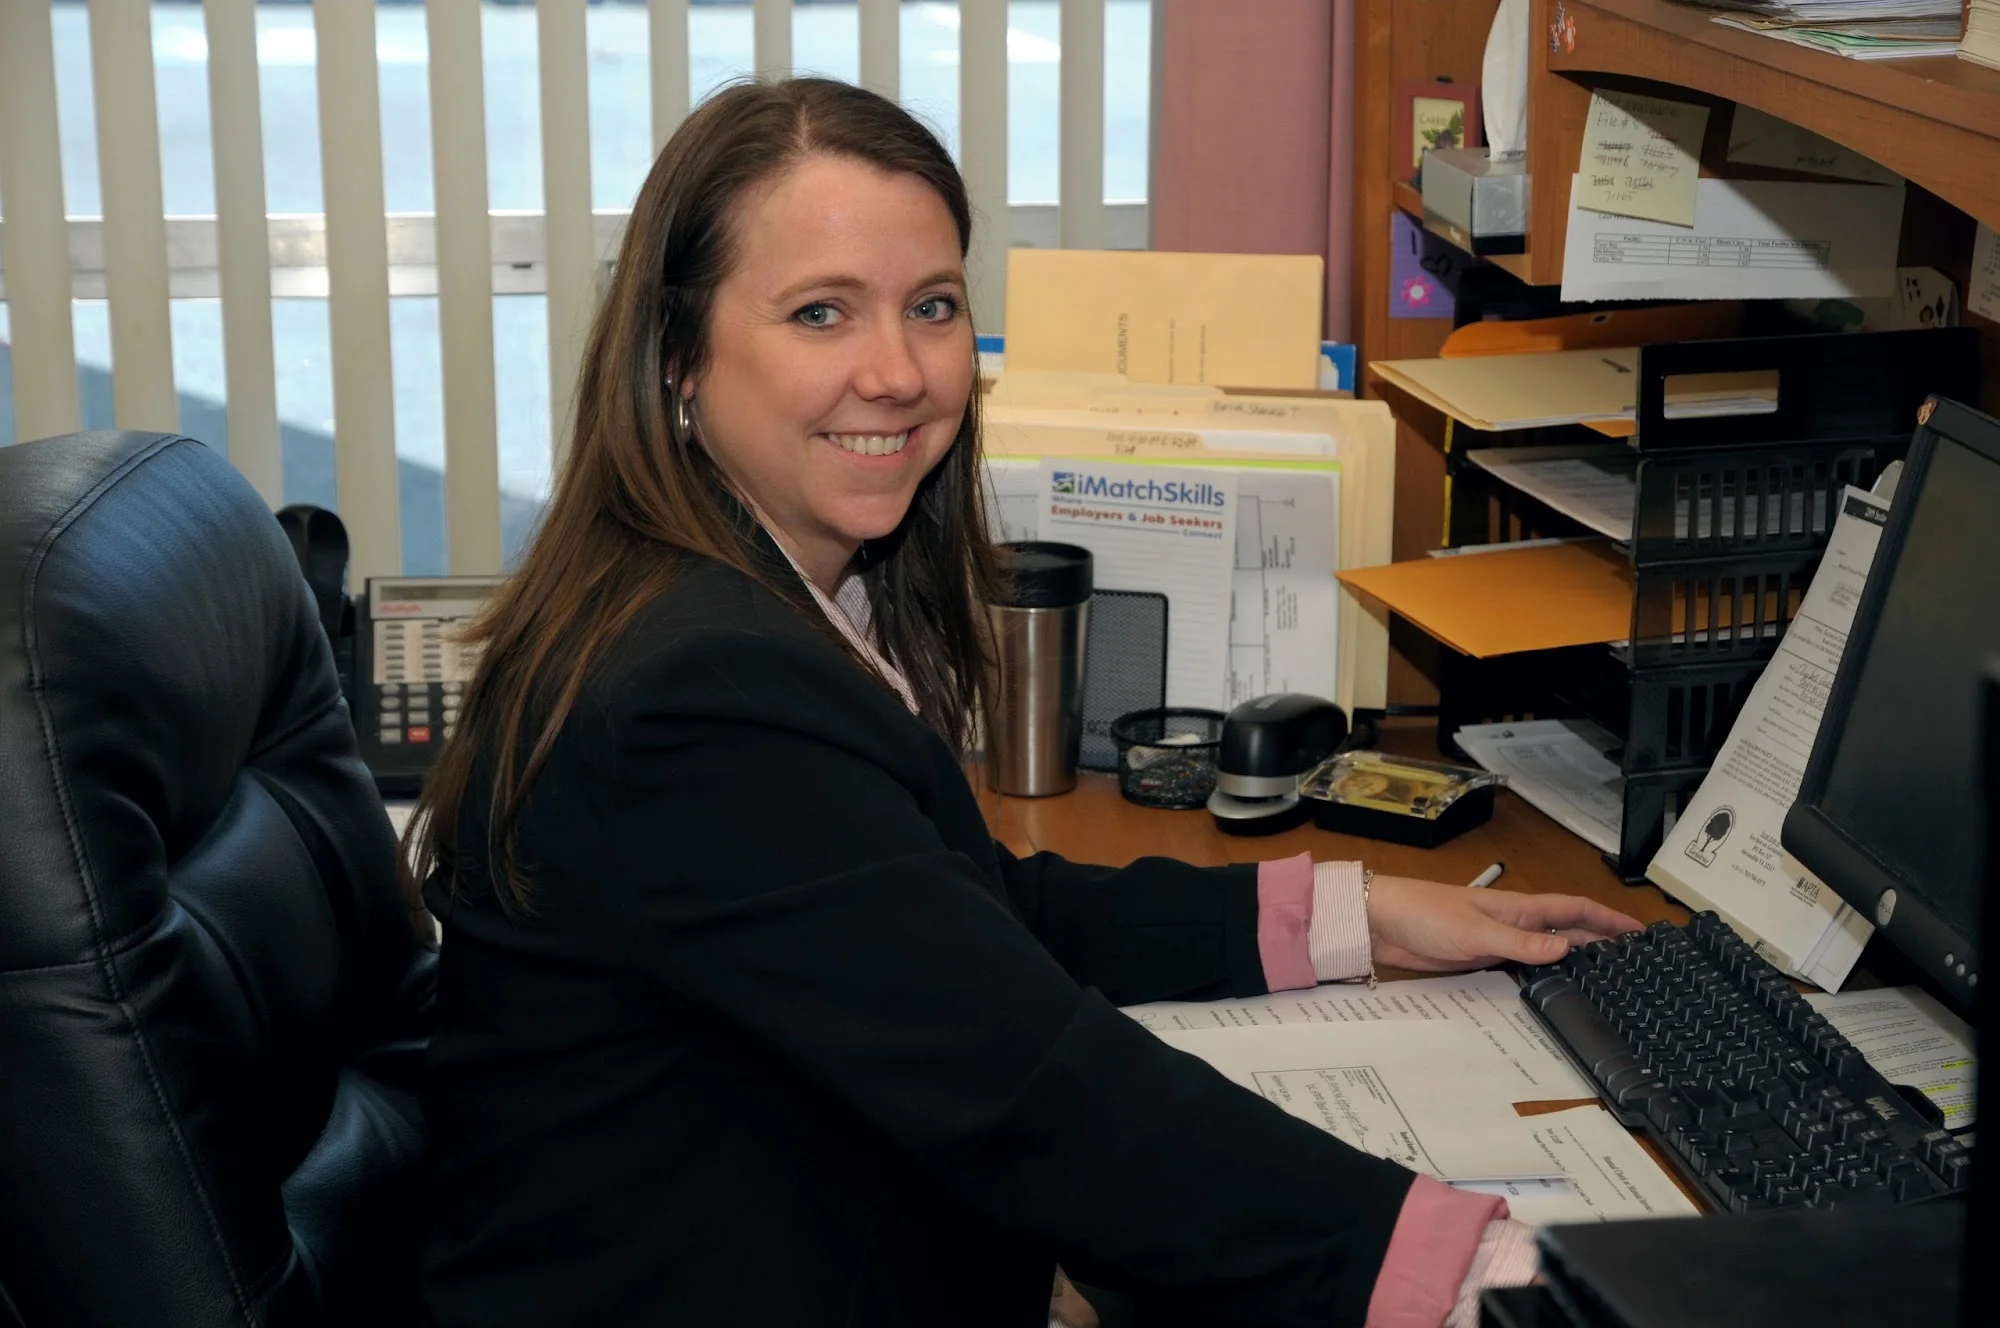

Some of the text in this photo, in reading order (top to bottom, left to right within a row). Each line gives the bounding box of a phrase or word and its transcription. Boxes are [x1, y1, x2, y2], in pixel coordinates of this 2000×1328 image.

[1078, 475, 1225, 506] iMatchSkills
[1051, 505, 1223, 529] Employers & Job Seekers
[1801, 878, 1820, 897] APTA
